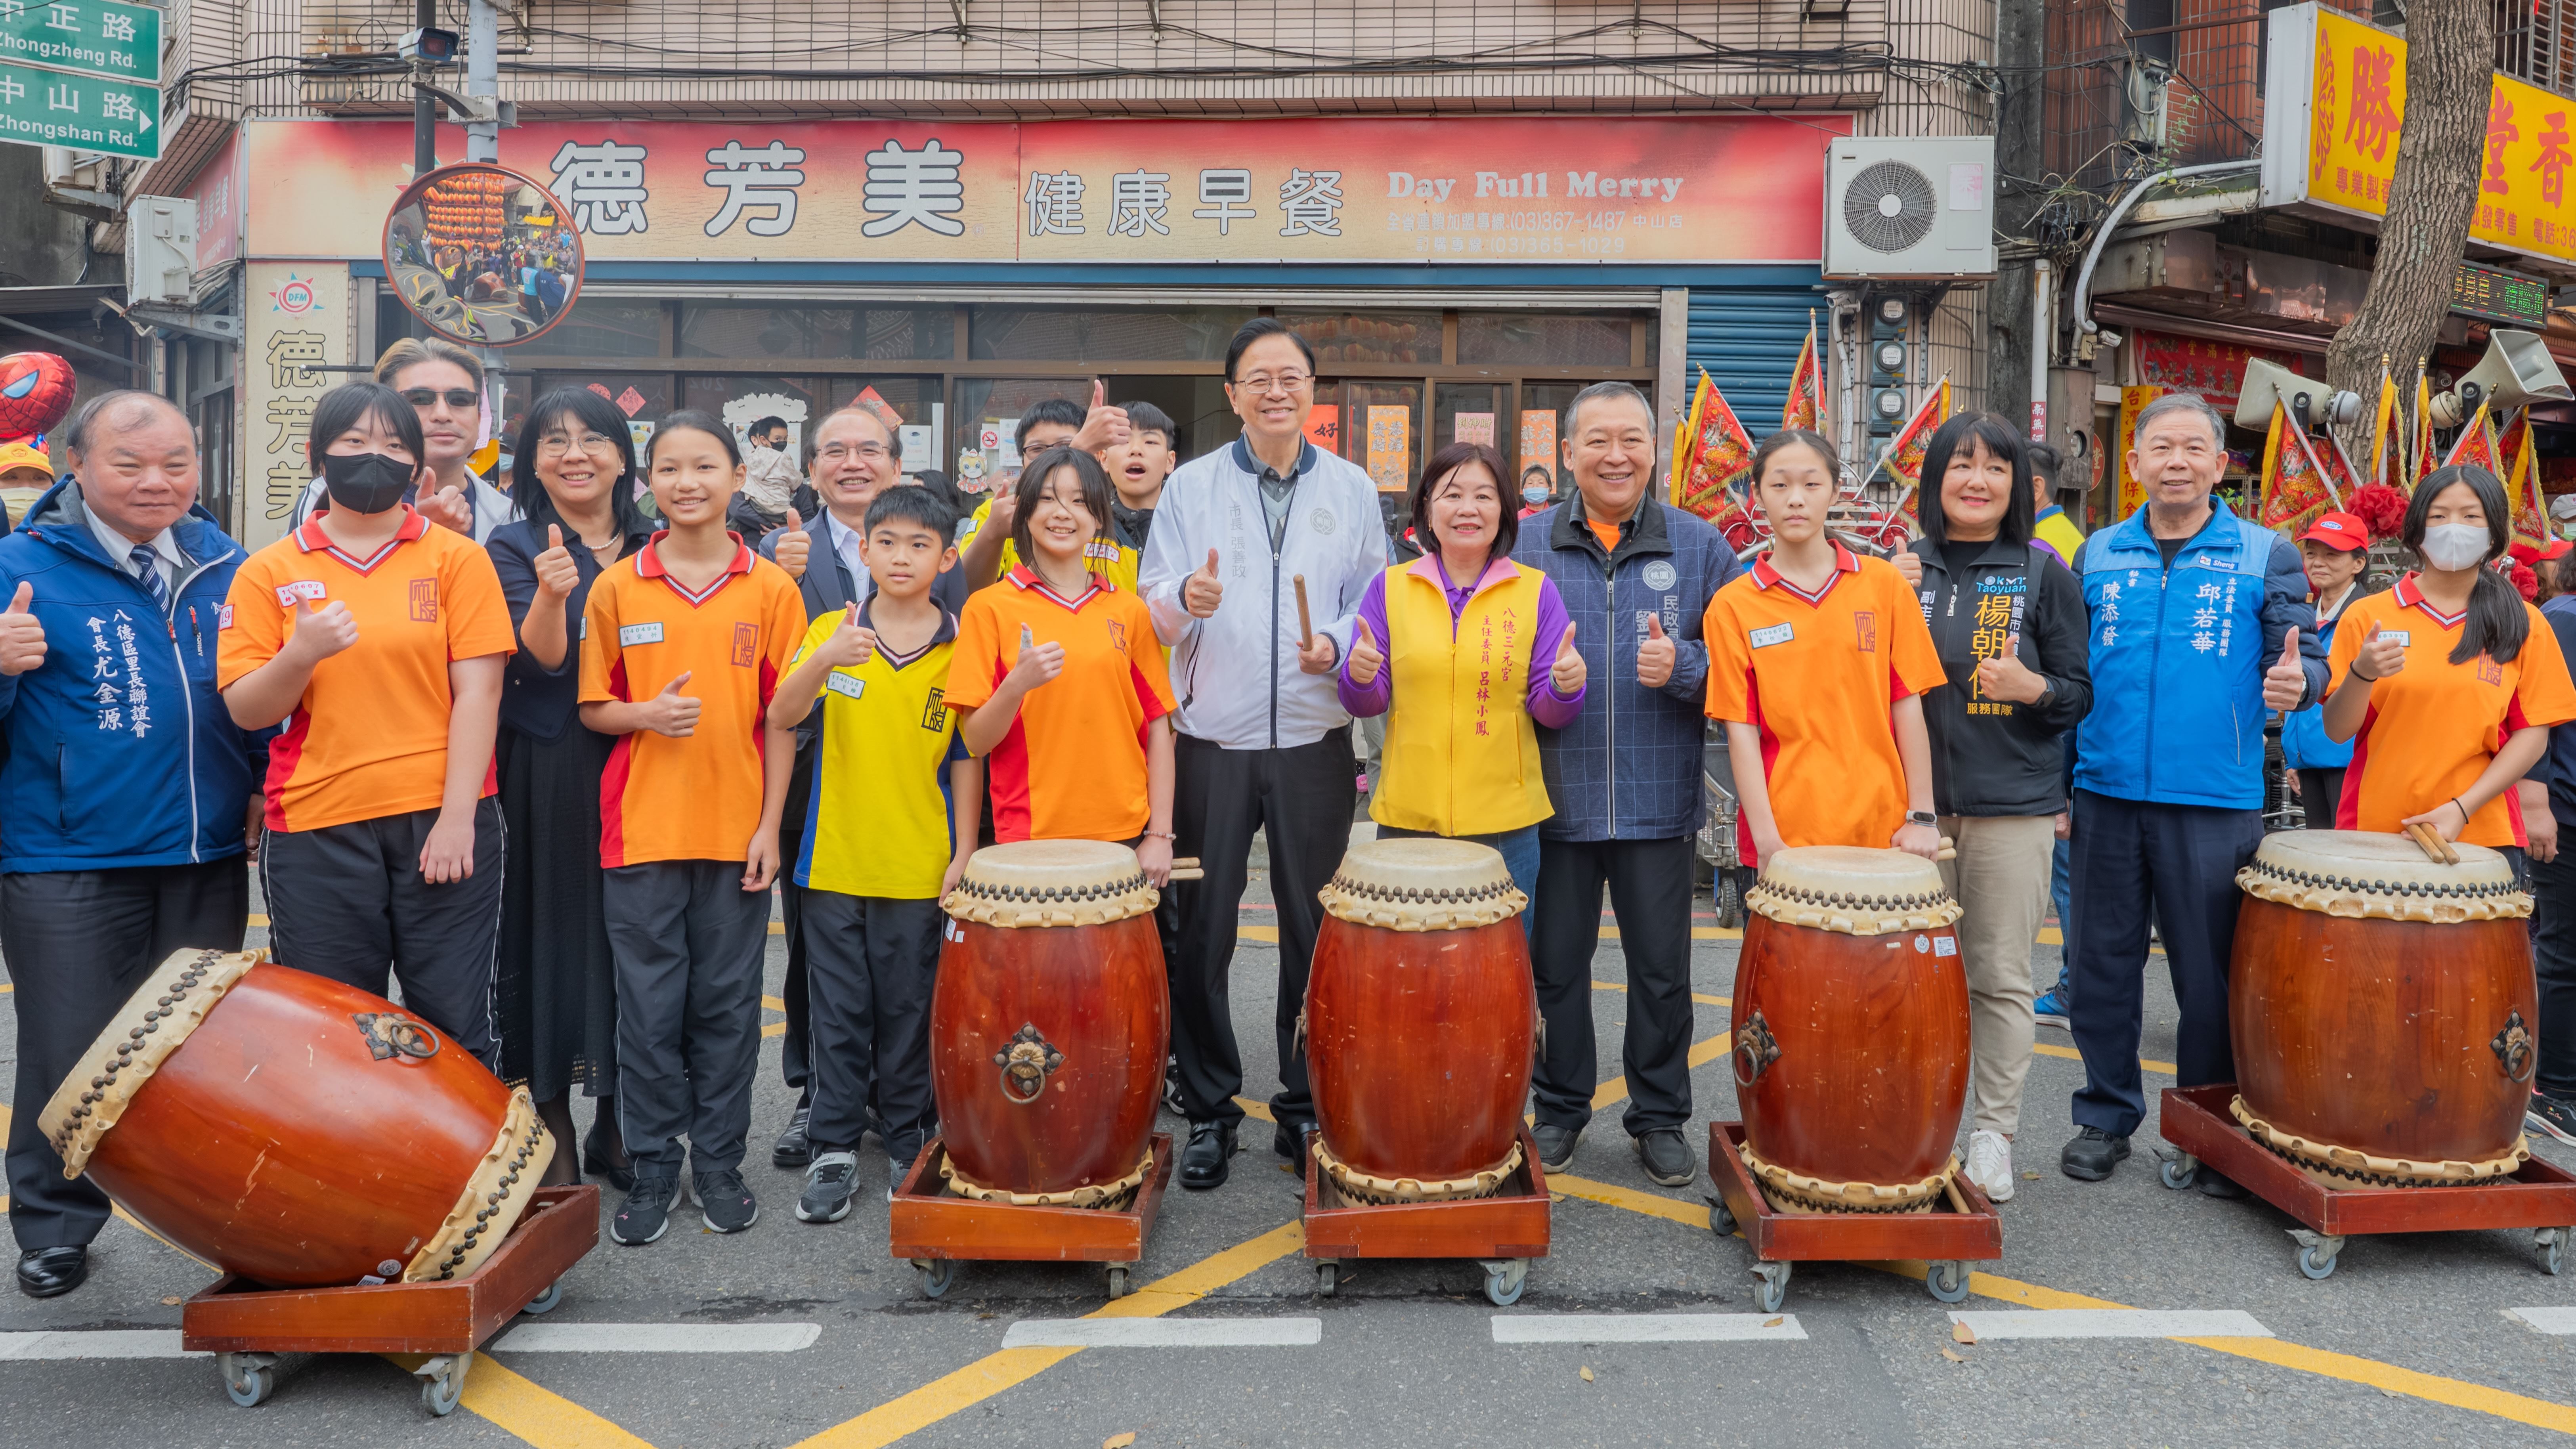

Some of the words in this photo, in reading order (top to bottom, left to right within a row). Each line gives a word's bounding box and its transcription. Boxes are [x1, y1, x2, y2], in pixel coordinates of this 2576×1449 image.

[0, 0, 136, 42] 中正路
[0, 32, 105, 66] hongzheng
[111, 50, 137, 69] Rd.
[0, 75, 136, 121] 中山路
[109, 130, 138, 147] Rd.
[548, 138, 965, 238] 德芳美
[1024, 168, 1343, 237] 健康早餐
[1387, 171, 1457, 203] Day
[1475, 172, 1549, 198] Full
[1566, 172, 1684, 203] Merry
[1633, 214, 1683, 229] 中山店
[1314, 422, 1338, 438] 好
[1229, 504, 1244, 531] 市長
[1231, 536, 1246, 578] 張善政
[1651, 571, 1669, 579] 桃園
[2213, 560, 2235, 569] Sheng
[1976, 582, 2026, 595] Taoyuan
[2224, 577, 2238, 614] 立法委員
[221, 610, 230, 624] 19
[1920, 590, 1936, 626] 副主
[2101, 581, 2121, 646] 陳添發
[2190, 583, 2221, 654] 邱若華
[623, 626, 657, 635] 1140494
[1481, 615, 1493, 665] 主任委員
[1501, 607, 1517, 682] 八德三元宮
[2219, 619, 2232, 657] 服務團隊
[114, 609, 152, 738] 八德區里長聯誼會
[1475, 671, 1491, 736] 呂林小鳳
[1967, 703, 2013, 716] 服務團隊
[816, 1156, 836, 1166] combat
